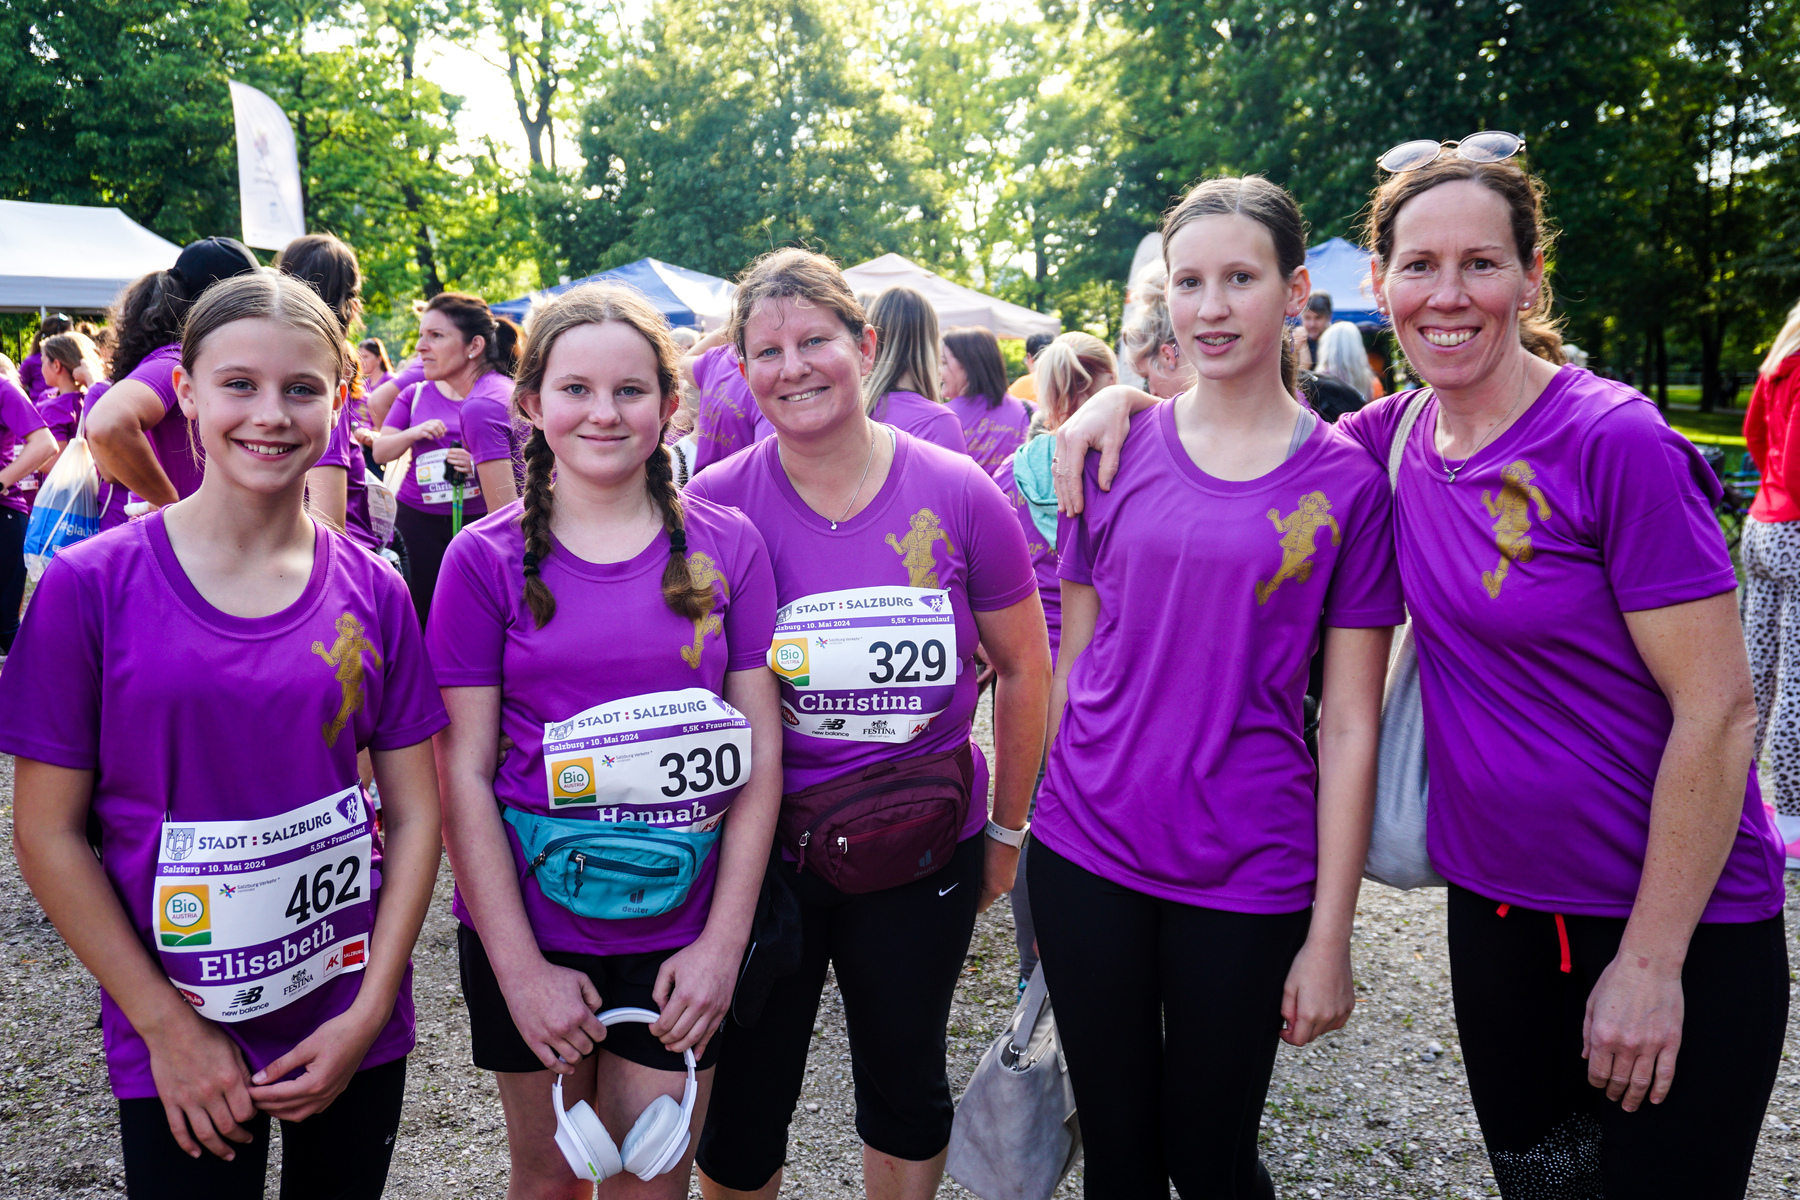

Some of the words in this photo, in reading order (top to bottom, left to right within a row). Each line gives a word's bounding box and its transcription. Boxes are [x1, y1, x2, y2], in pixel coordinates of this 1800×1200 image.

[796, 602, 835, 614] STADT
[846, 597, 914, 609] SALZBURG
[775, 624, 801, 632] alzburg
[806, 621, 817, 629] 10.
[833, 620, 850, 628] 2024
[912, 615, 950, 623] Frauenlauf
[780, 649, 800, 659] Bio
[868, 639, 947, 684] 329
[799, 691, 922, 712] Christina
[577, 711, 621, 728] STADT
[633, 700, 707, 720] SALZBURG
[682, 724, 700, 733] 5,5K
[705, 719, 746, 730] Frauenlauf
[549, 741, 585, 752] Salzburg
[590, 738, 602, 746] 10.
[603, 735, 618, 745] Mai
[620, 733, 639, 743] 2024
[563, 771, 584, 785] Bio
[659, 742, 741, 798] 330
[597, 802, 707, 824] Hannah
[198, 836, 248, 850] STADT
[262, 812, 332, 845] SALZBURG
[310, 841, 326, 852] 5,5K
[331, 825, 366, 845] Frauenlauf
[163, 864, 200, 875] Salzburg
[208, 864, 222, 873] 10.
[224, 862, 242, 872] Mai
[244, 860, 266, 871] 2024
[285, 855, 361, 925] 462
[172, 899, 197, 913] Bio
[622, 904, 649, 914] deuter
[199, 921, 336, 981] Elisabeth
[343, 949, 364, 959] SALZBURG
[283, 974, 314, 996] FESTINA
[239, 1002, 270, 1016] balance
